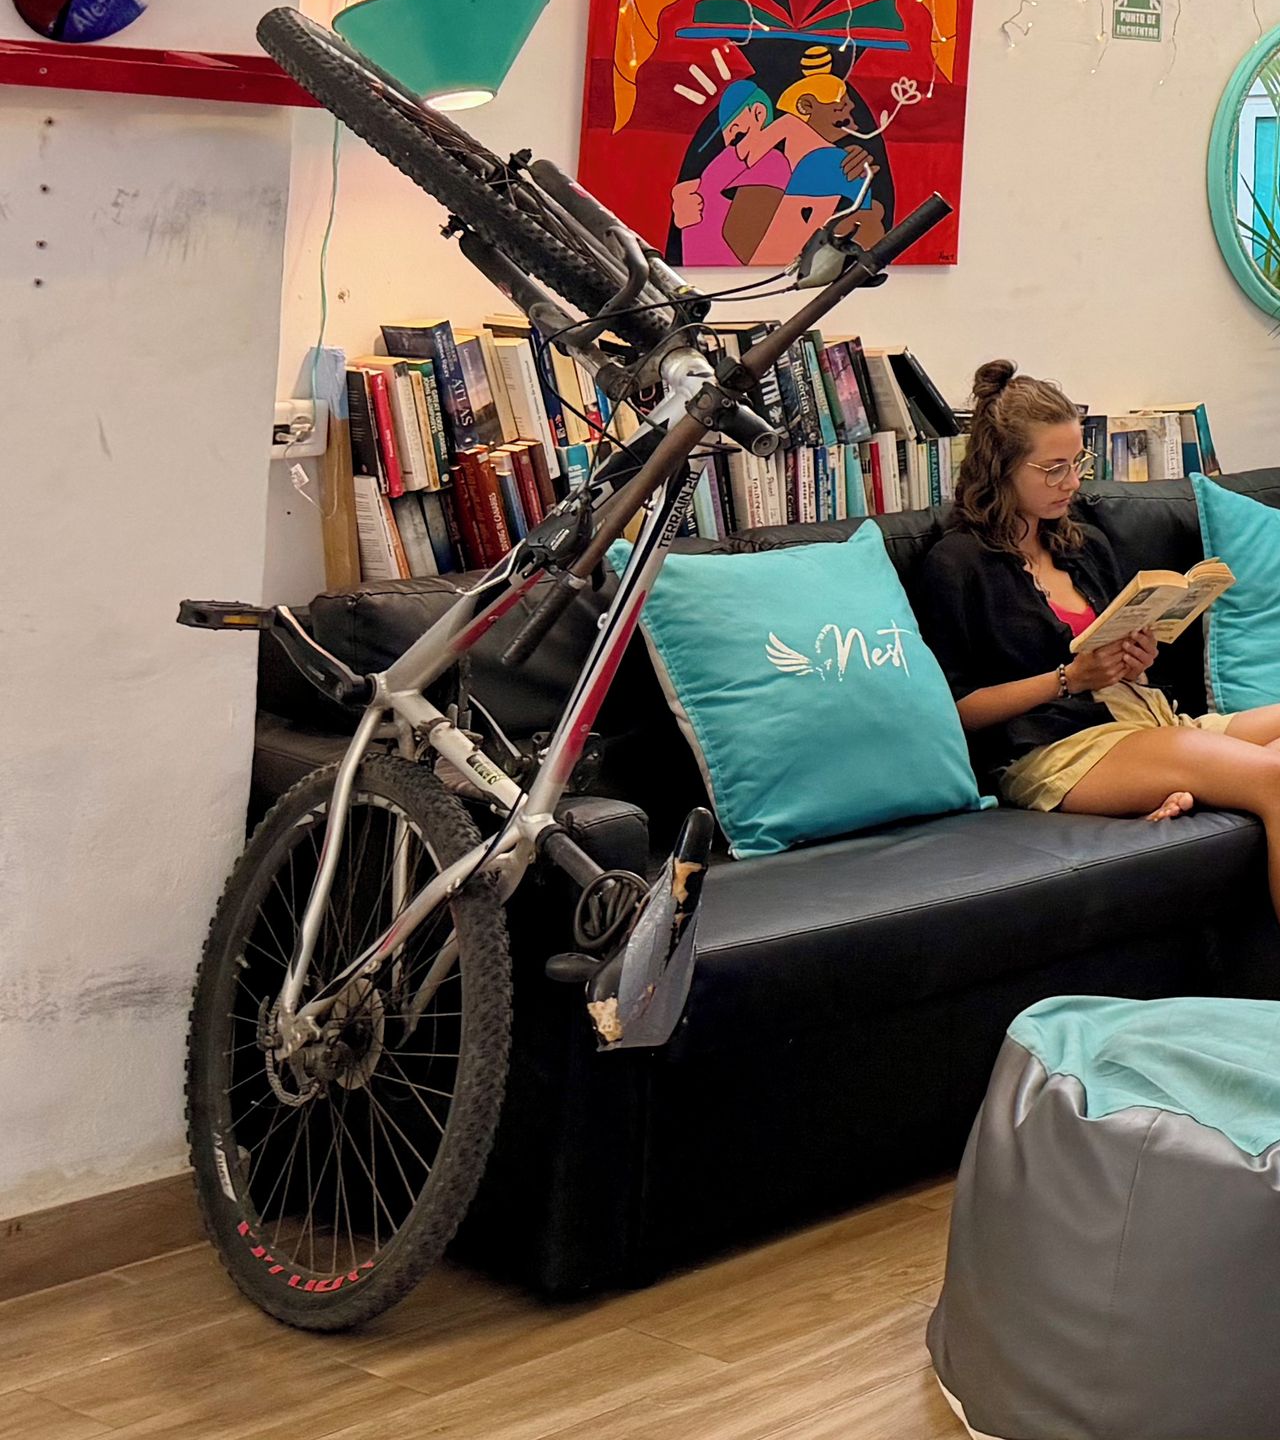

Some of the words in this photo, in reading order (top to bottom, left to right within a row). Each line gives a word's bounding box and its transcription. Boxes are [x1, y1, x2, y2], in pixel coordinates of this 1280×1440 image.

[1117, 24, 1158, 37] ENCUENTRO
[1121, 11, 1145, 24] PUNTO
[1147, 14, 1155, 24] DE
[451, 376, 473, 427] ATLAS
[791, 359, 811, 414] Historian
[657, 490, 693, 549] TERRAIN
[686, 471, 700, 494] 20
[815, 619, 912, 681] Nest
